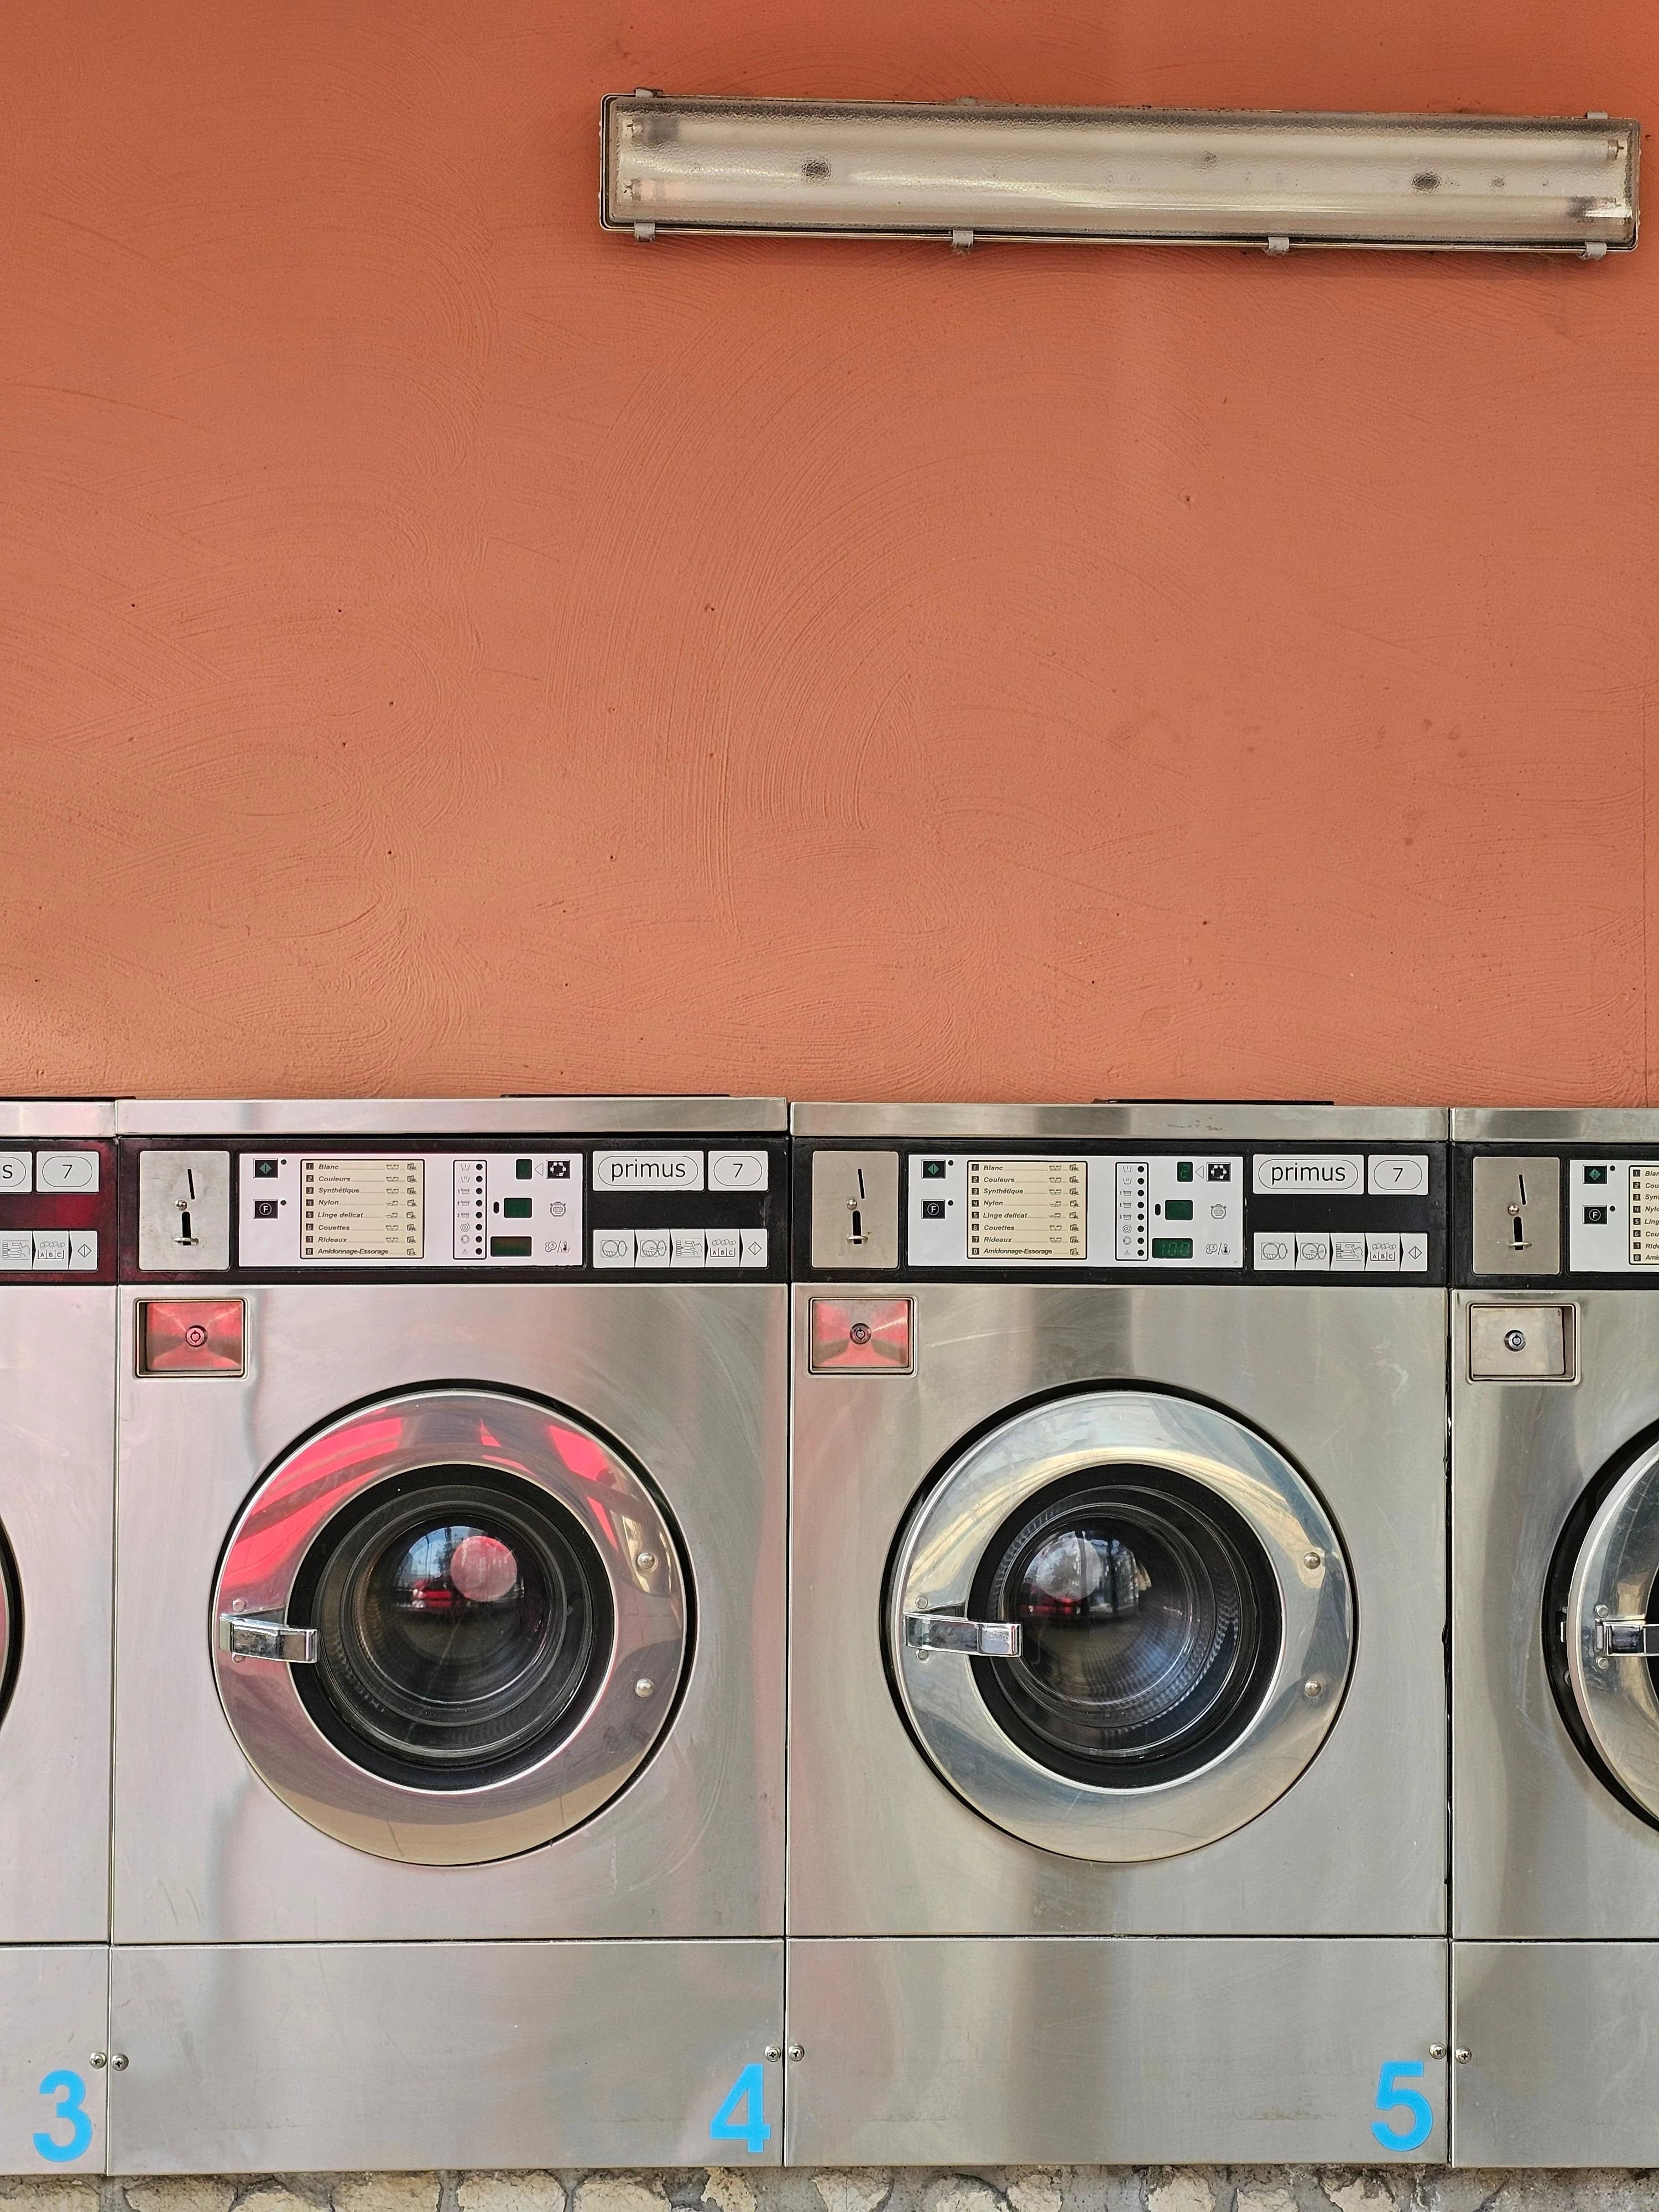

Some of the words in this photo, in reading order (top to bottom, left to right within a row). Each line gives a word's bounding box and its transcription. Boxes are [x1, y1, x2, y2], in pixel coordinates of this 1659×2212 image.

[62, 1164, 72, 1179] 7
[612, 1159, 686, 1182] primus
[733, 1163, 743, 1178] 7
[1272, 1162, 1345, 1185] primus
[1393, 1167, 1404, 1182] 7
[33, 2069, 93, 2163] 3
[709, 2063, 771, 2153] 4
[1370, 2061, 1433, 2152] 5
